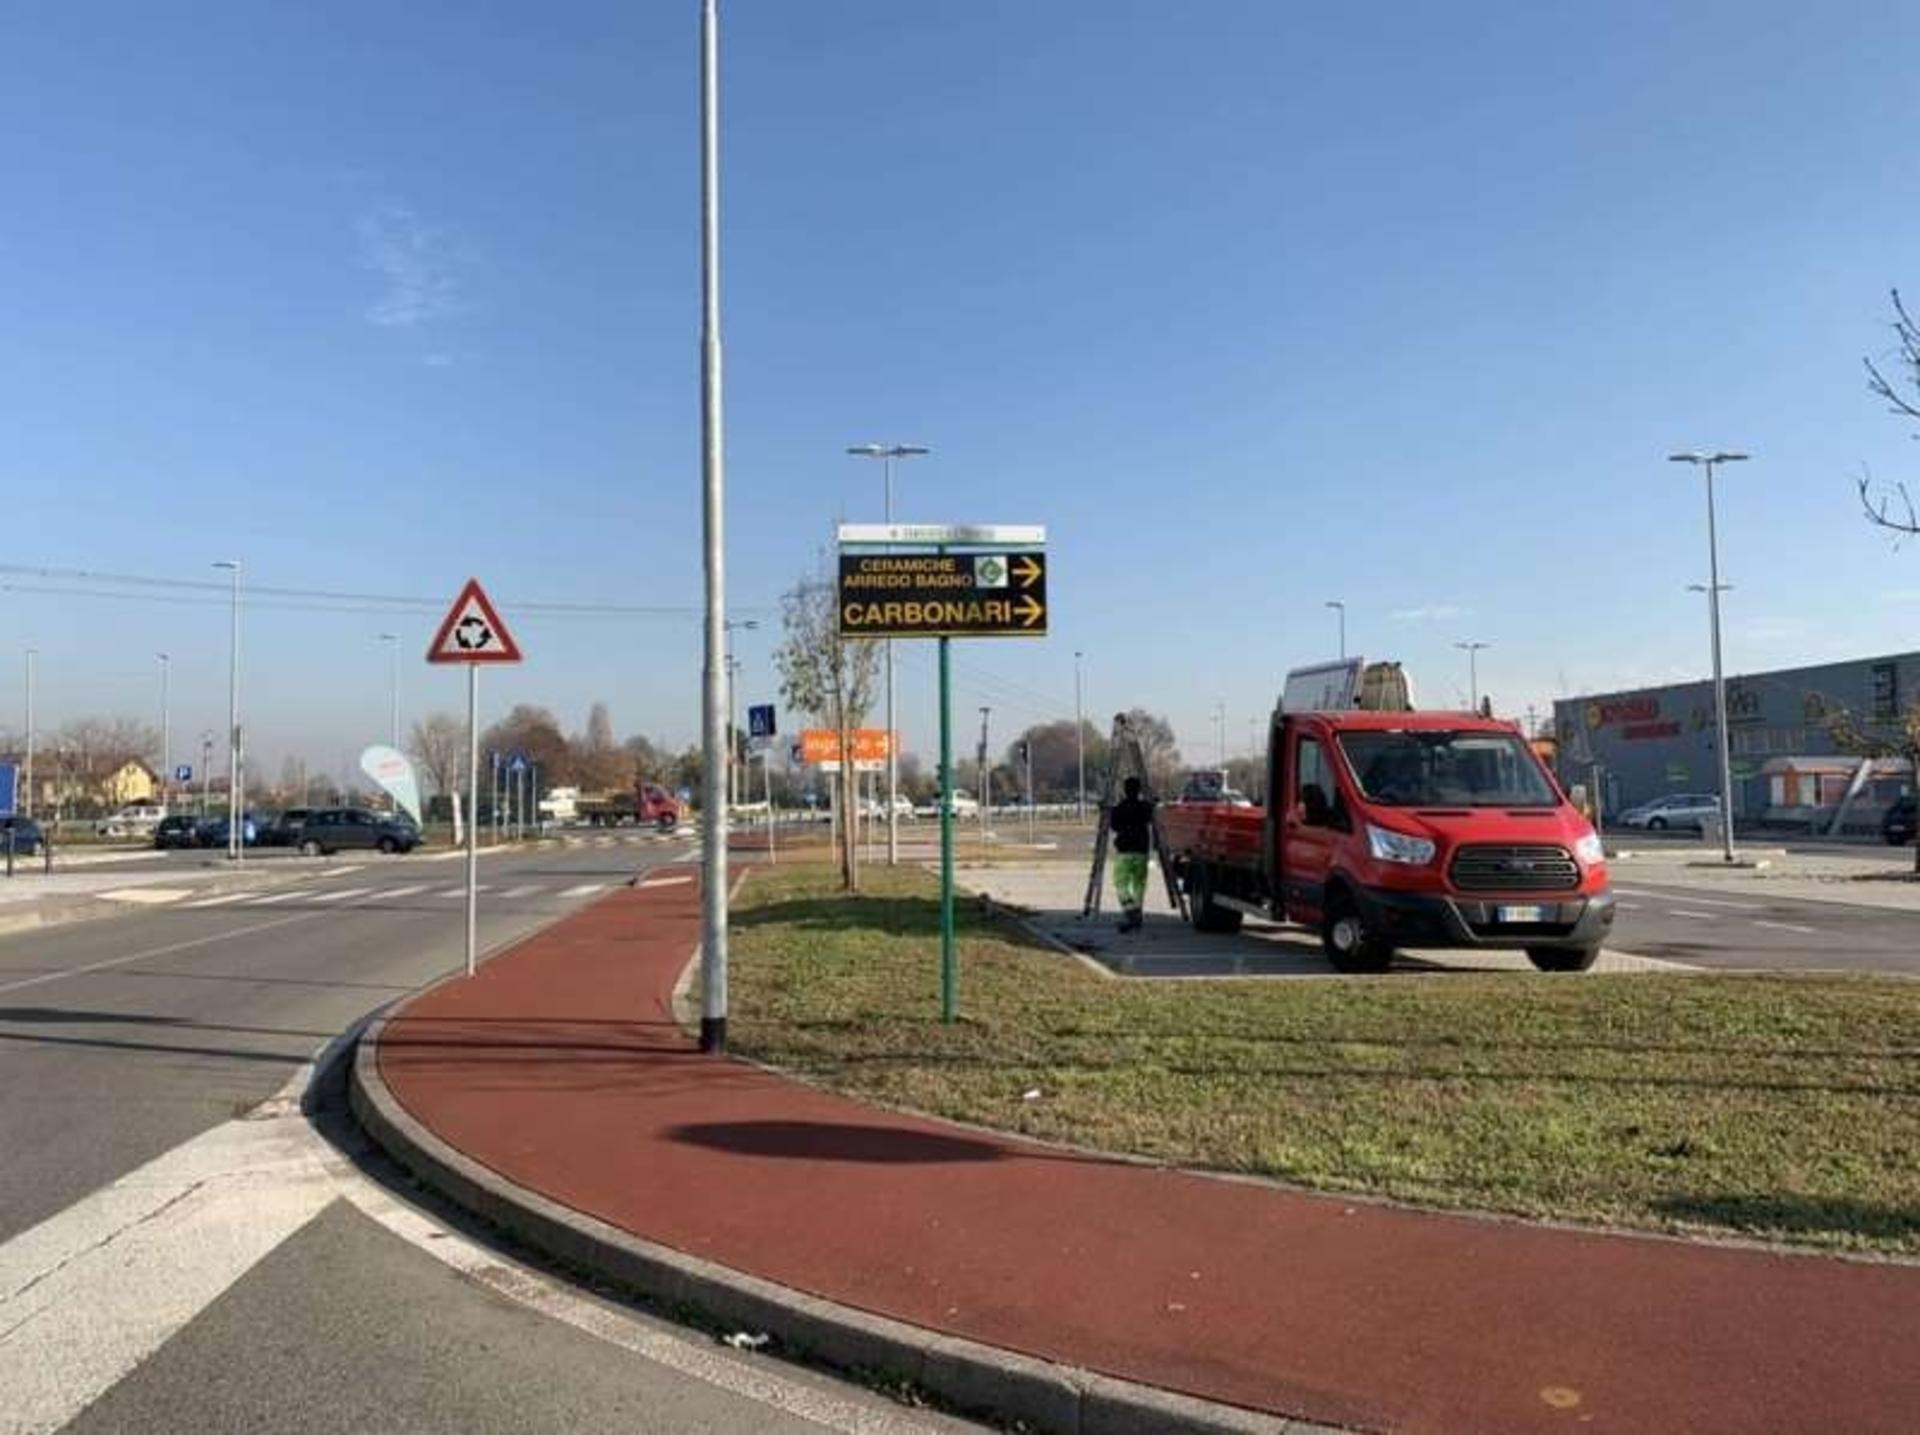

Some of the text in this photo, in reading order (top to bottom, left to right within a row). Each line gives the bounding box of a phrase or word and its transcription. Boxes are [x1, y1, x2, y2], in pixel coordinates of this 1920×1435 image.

[860, 558, 956, 572] CERAMICHE
[844, 574, 973, 588] ARREDO BAGNO
[844, 602, 1011, 624] CARBONARI
